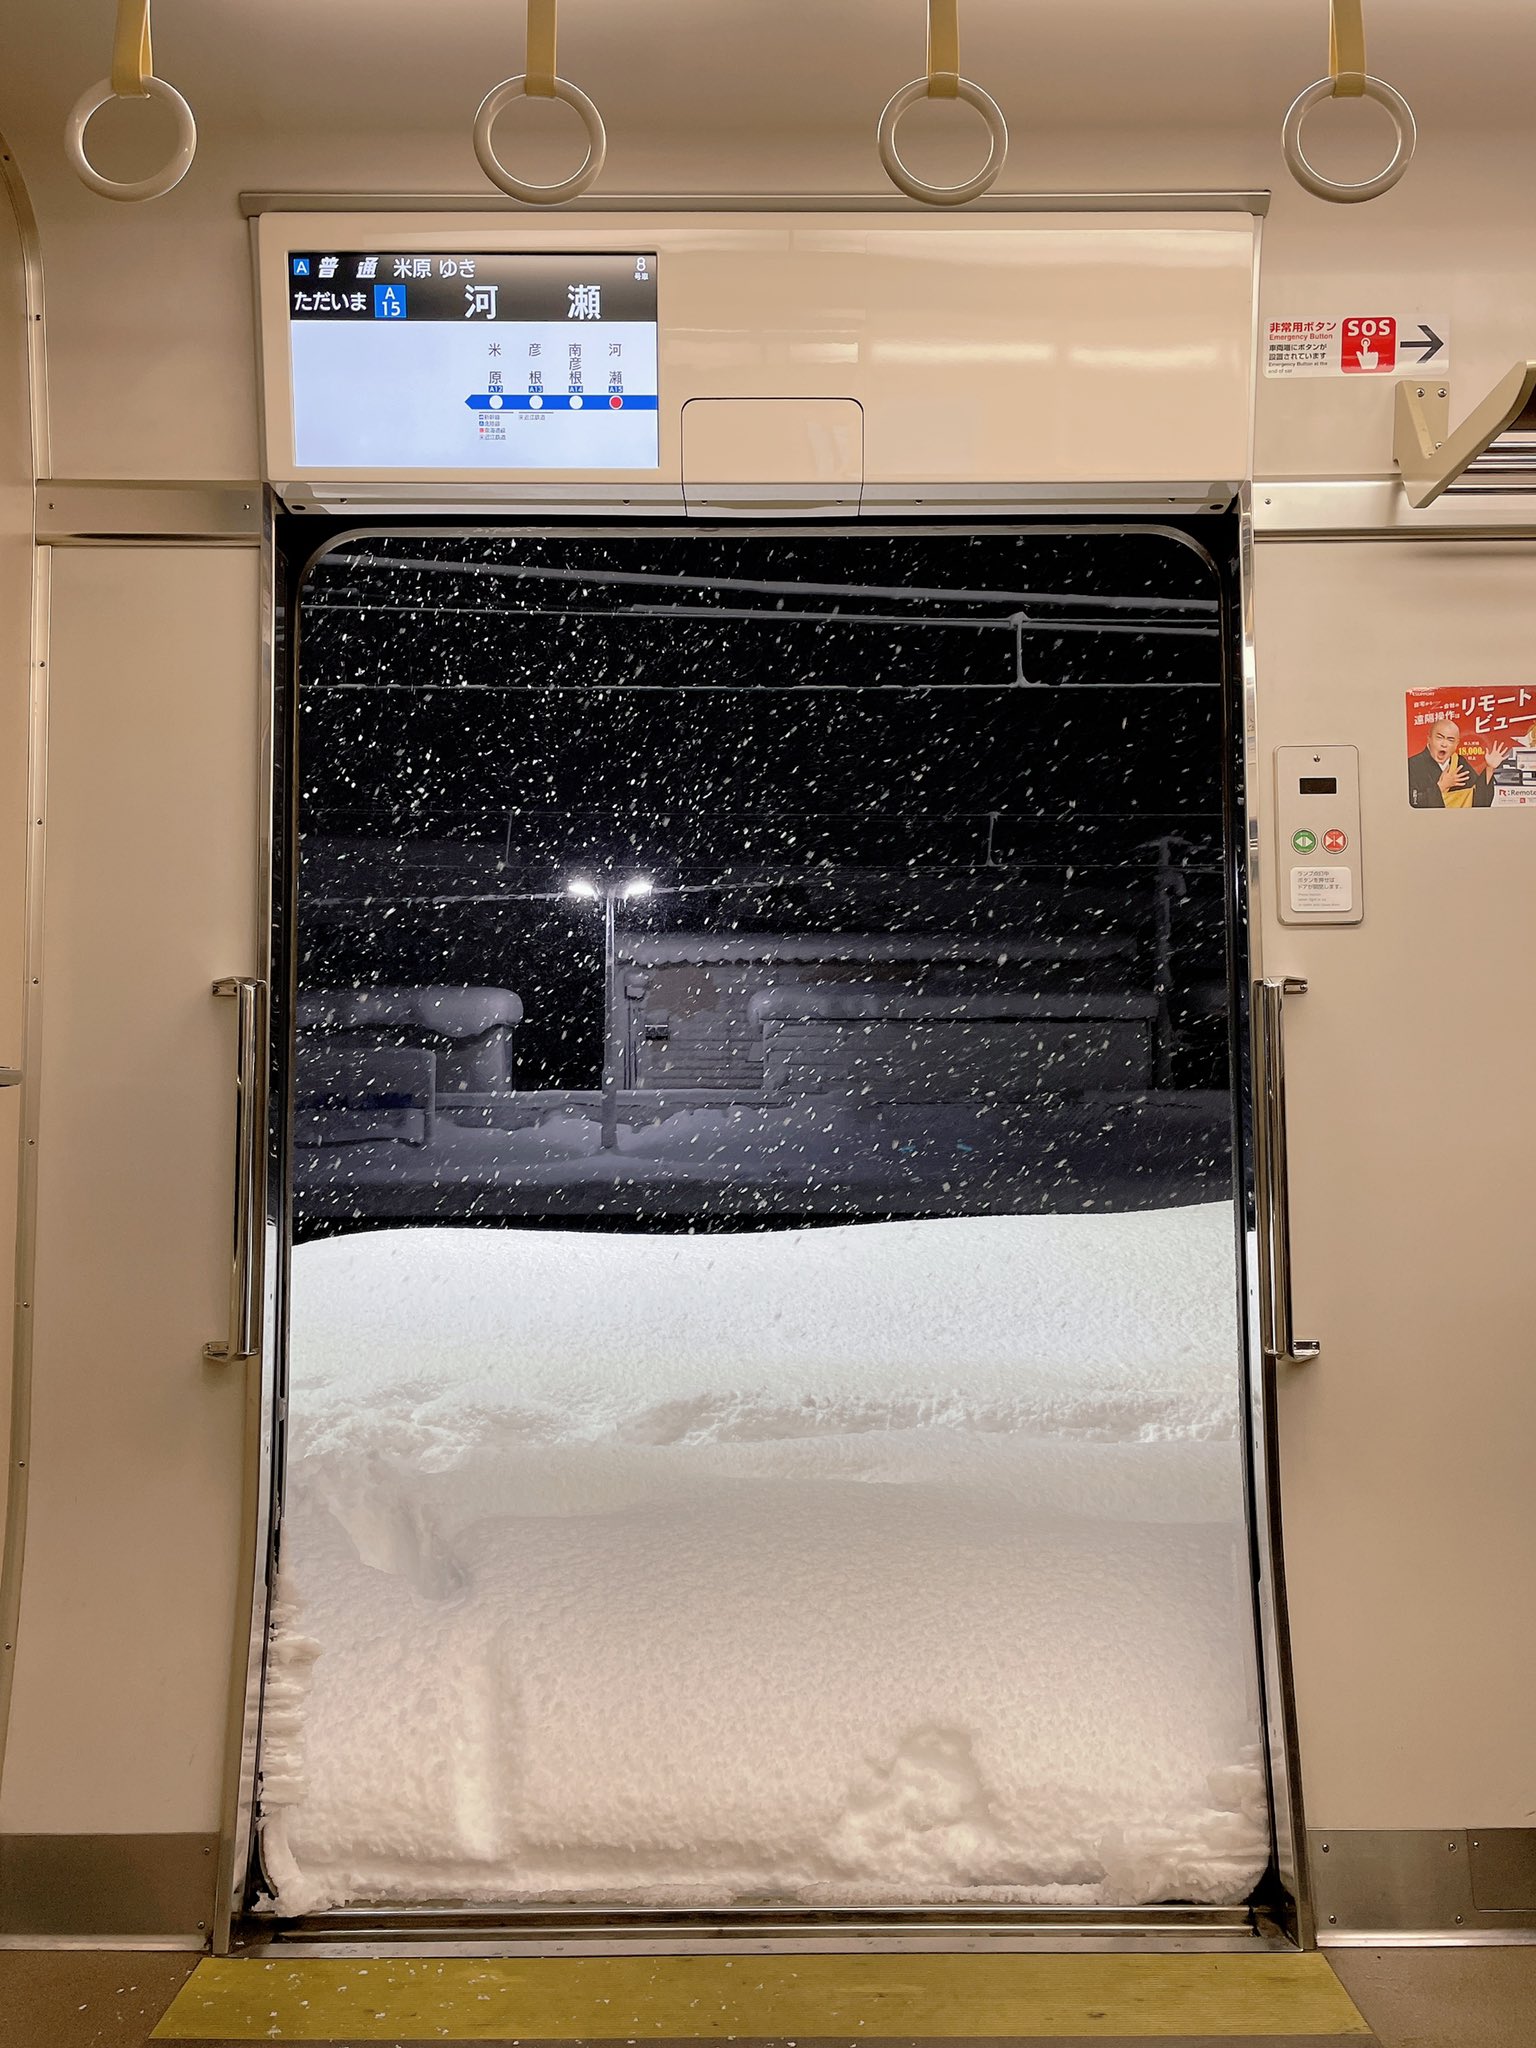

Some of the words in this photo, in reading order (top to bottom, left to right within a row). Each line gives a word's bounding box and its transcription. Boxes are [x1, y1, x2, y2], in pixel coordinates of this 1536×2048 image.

[296, 261, 308, 274] A
[318, 256, 379, 279] 普通
[393, 258, 432, 279] 米原
[439, 258, 476, 279] ゆき
[636, 257, 646, 271] 8
[294, 291, 367, 312] ただいま
[384, 287, 396, 300] A
[464, 284, 602, 320] 河瀬
[381, 301, 401, 316] 15
[1269, 321, 1337, 333] 非常用ボタン
[1347, 319, 1391, 337] SOS
[1269, 333, 1308, 341] Emergency
[1268, 352, 1327, 361] 設置されています
[1269, 343, 1328, 352] 車両端にボタンが
[488, 343, 503, 385] 米原
[528, 343, 543, 385] 彦根
[568, 343, 583, 385] 南彦根
[608, 343, 623, 385] 河瀬
[1461, 688, 1533, 717] リモート
